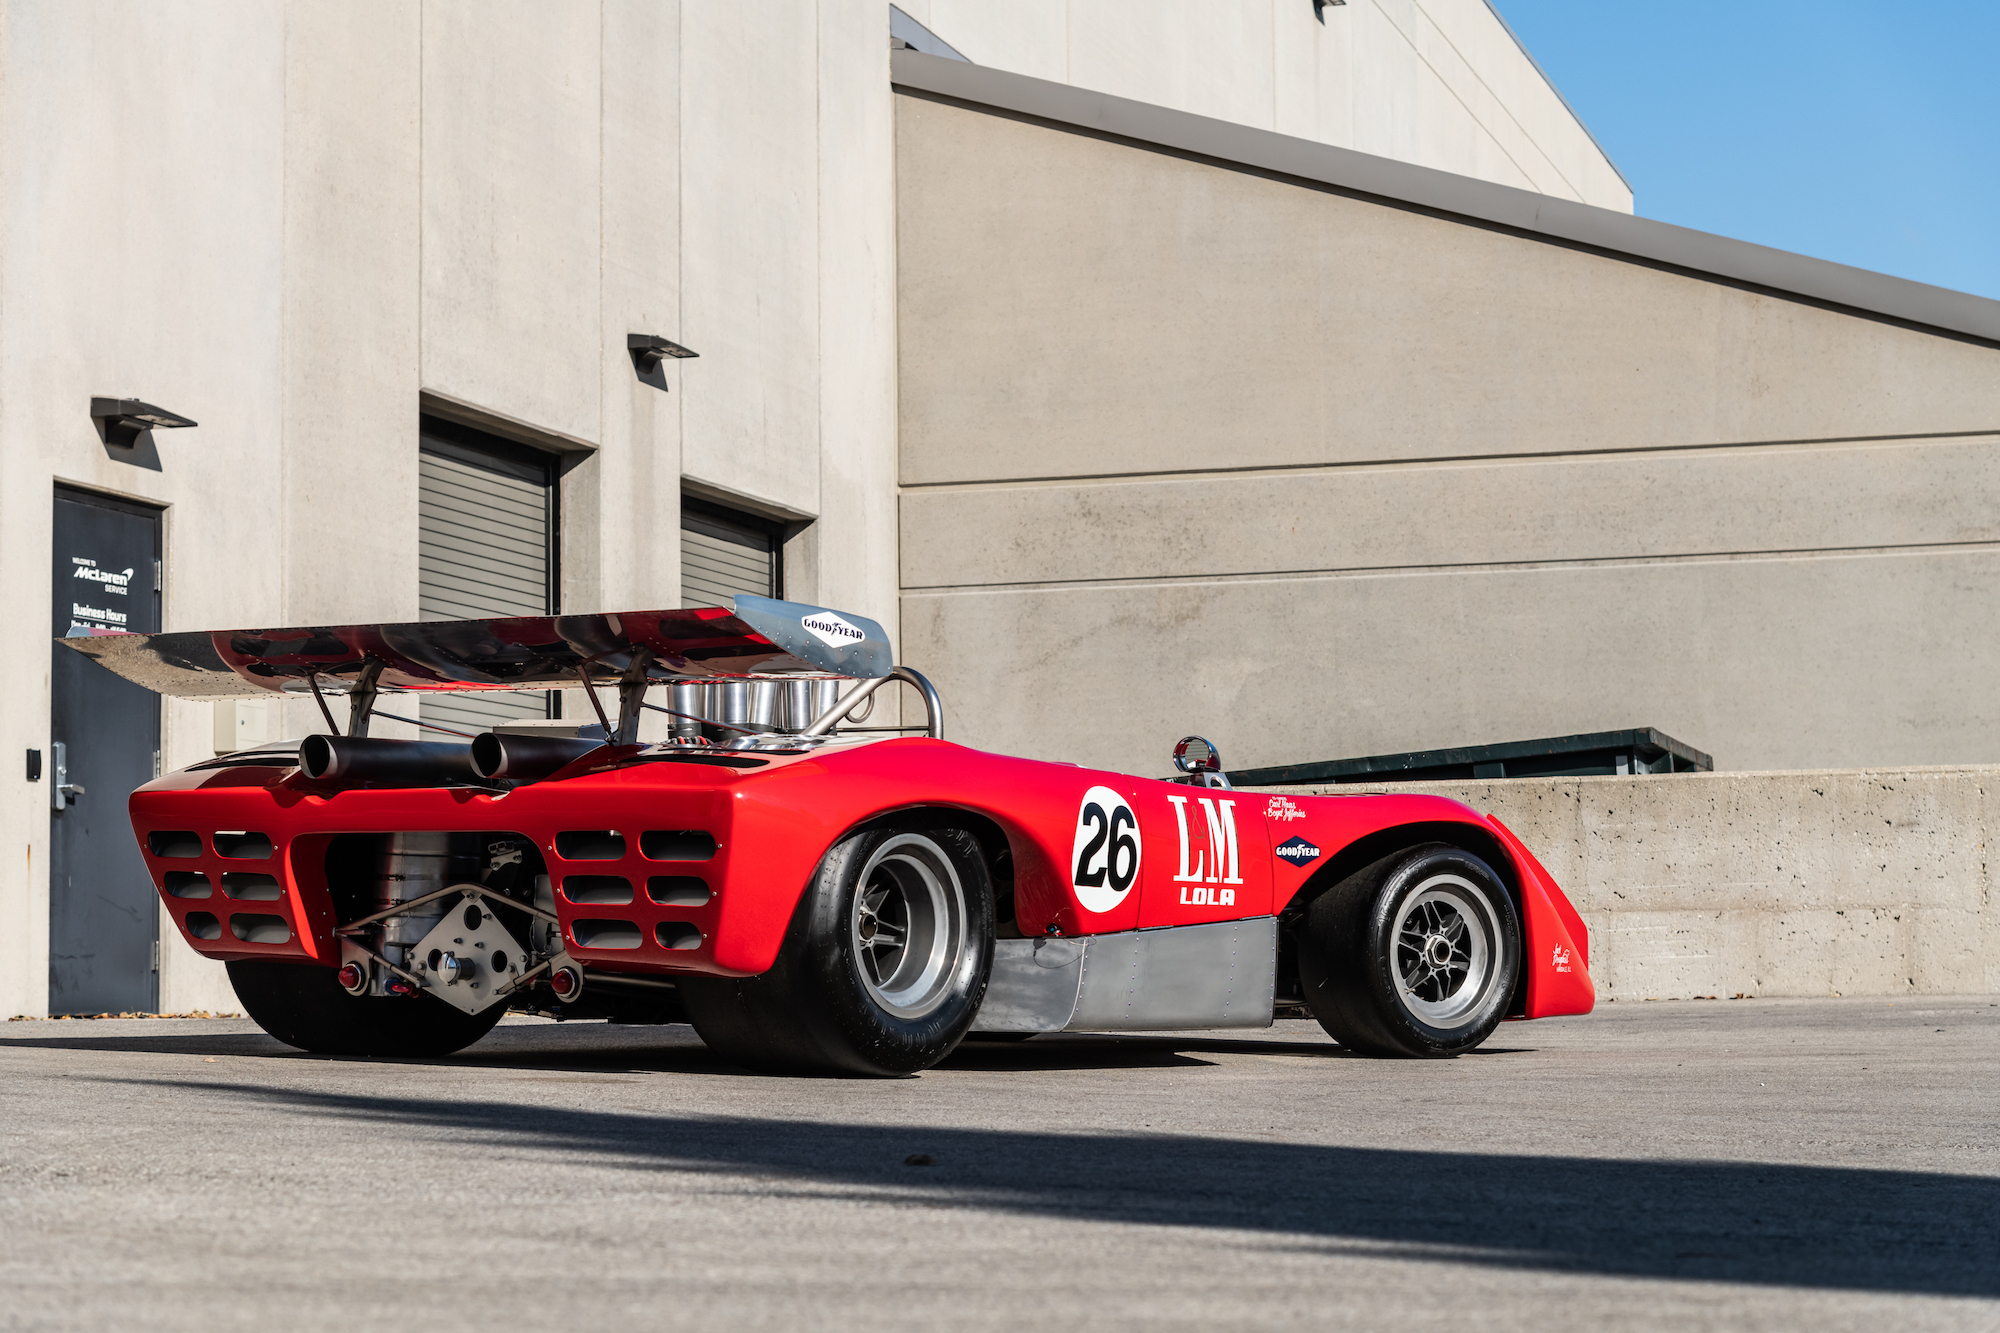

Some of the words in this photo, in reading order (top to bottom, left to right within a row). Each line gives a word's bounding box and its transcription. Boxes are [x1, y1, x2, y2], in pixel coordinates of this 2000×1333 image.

[73, 566, 128, 586] McLaren
[104, 584, 128, 595] SERVICE
[72, 602, 106, 619] Business
[106, 608, 127, 623] Hours
[804, 618, 863, 640] GOODYEAR
[1268, 808, 1283, 820] Boyd
[1269, 799, 1281, 808] Carl
[1282, 800, 1296, 809] Haas
[1074, 802, 1137, 892] 26
[1275, 845, 1320, 858] GOODYEAR
[1179, 886, 1235, 906] LOLA
